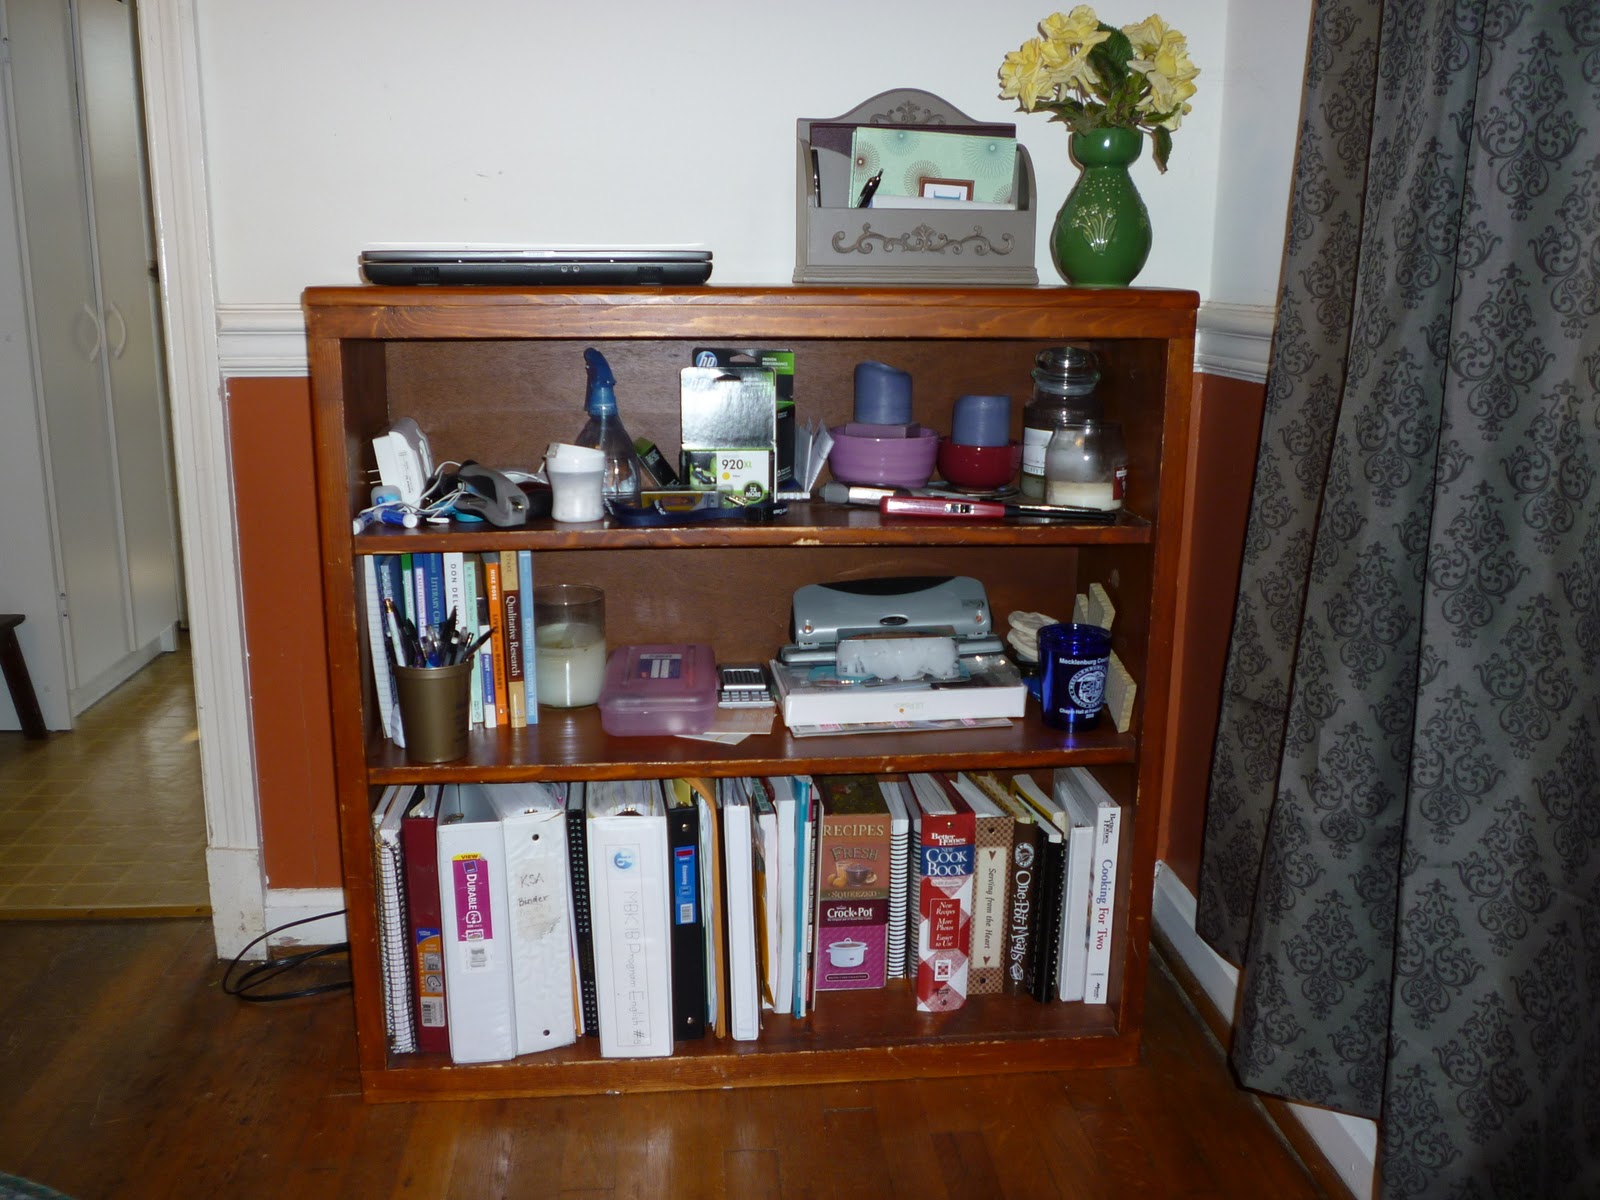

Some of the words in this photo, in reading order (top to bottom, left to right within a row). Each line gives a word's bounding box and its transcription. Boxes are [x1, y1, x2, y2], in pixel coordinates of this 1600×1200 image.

[450, 563, 458, 583] DON
[430, 577, 439, 610] LITERARY
[506, 595, 517, 640] Qualitative
[509, 641, 520, 676] Research
[823, 824, 884, 837] RECIPES
[931, 832, 956, 840] Better
[939, 838, 966, 846] Homes
[832, 846, 879, 861] FRESH
[520, 873, 544, 888] KSA
[985, 868, 996, 895] Serving
[1096, 859, 1113, 904] Cooking
[466, 874, 477, 910] DURABLE
[518, 894, 550, 907] Binder
[831, 890, 877, 898] SQUEEZED
[623, 890, 640, 926] MBK
[935, 908, 956, 916] Recipes
[985, 897, 995, 914] from
[937, 917, 953, 925] More
[985, 915, 994, 927] the
[1097, 907, 1110, 924] For
[936, 923, 954, 931] Photos
[936, 933, 953, 943] Easier
[984, 929, 993, 949] Heart
[1010, 924, 1029, 963] Meals
[1095, 928, 1108, 950] Two
[628, 990, 645, 1026] English
